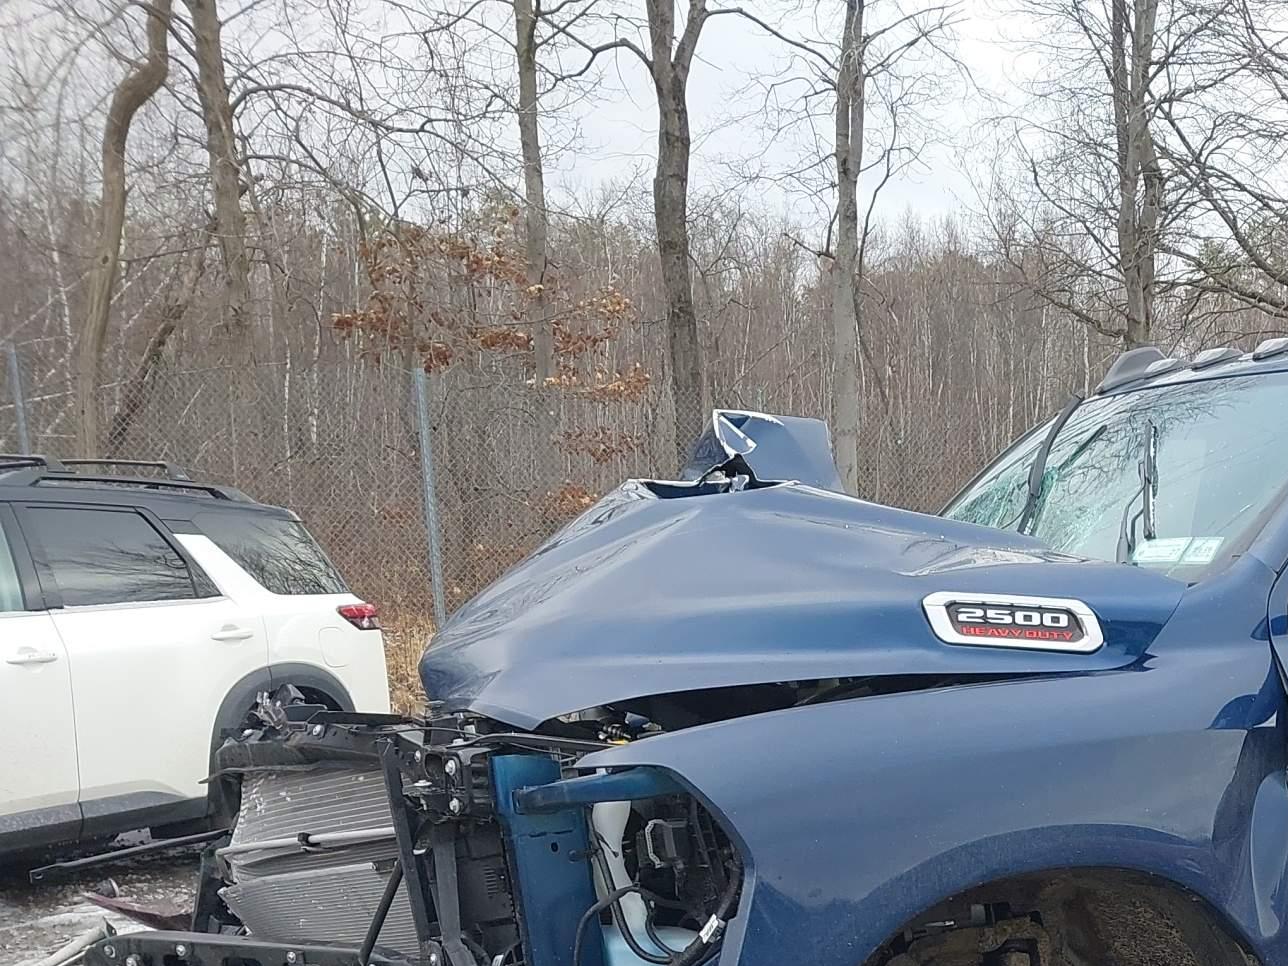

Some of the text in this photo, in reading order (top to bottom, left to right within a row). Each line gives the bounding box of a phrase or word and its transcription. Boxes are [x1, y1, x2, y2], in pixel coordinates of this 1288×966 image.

[957, 608, 1069, 628] 2500
[961, 626, 1073, 641] HEAVY DUTY
